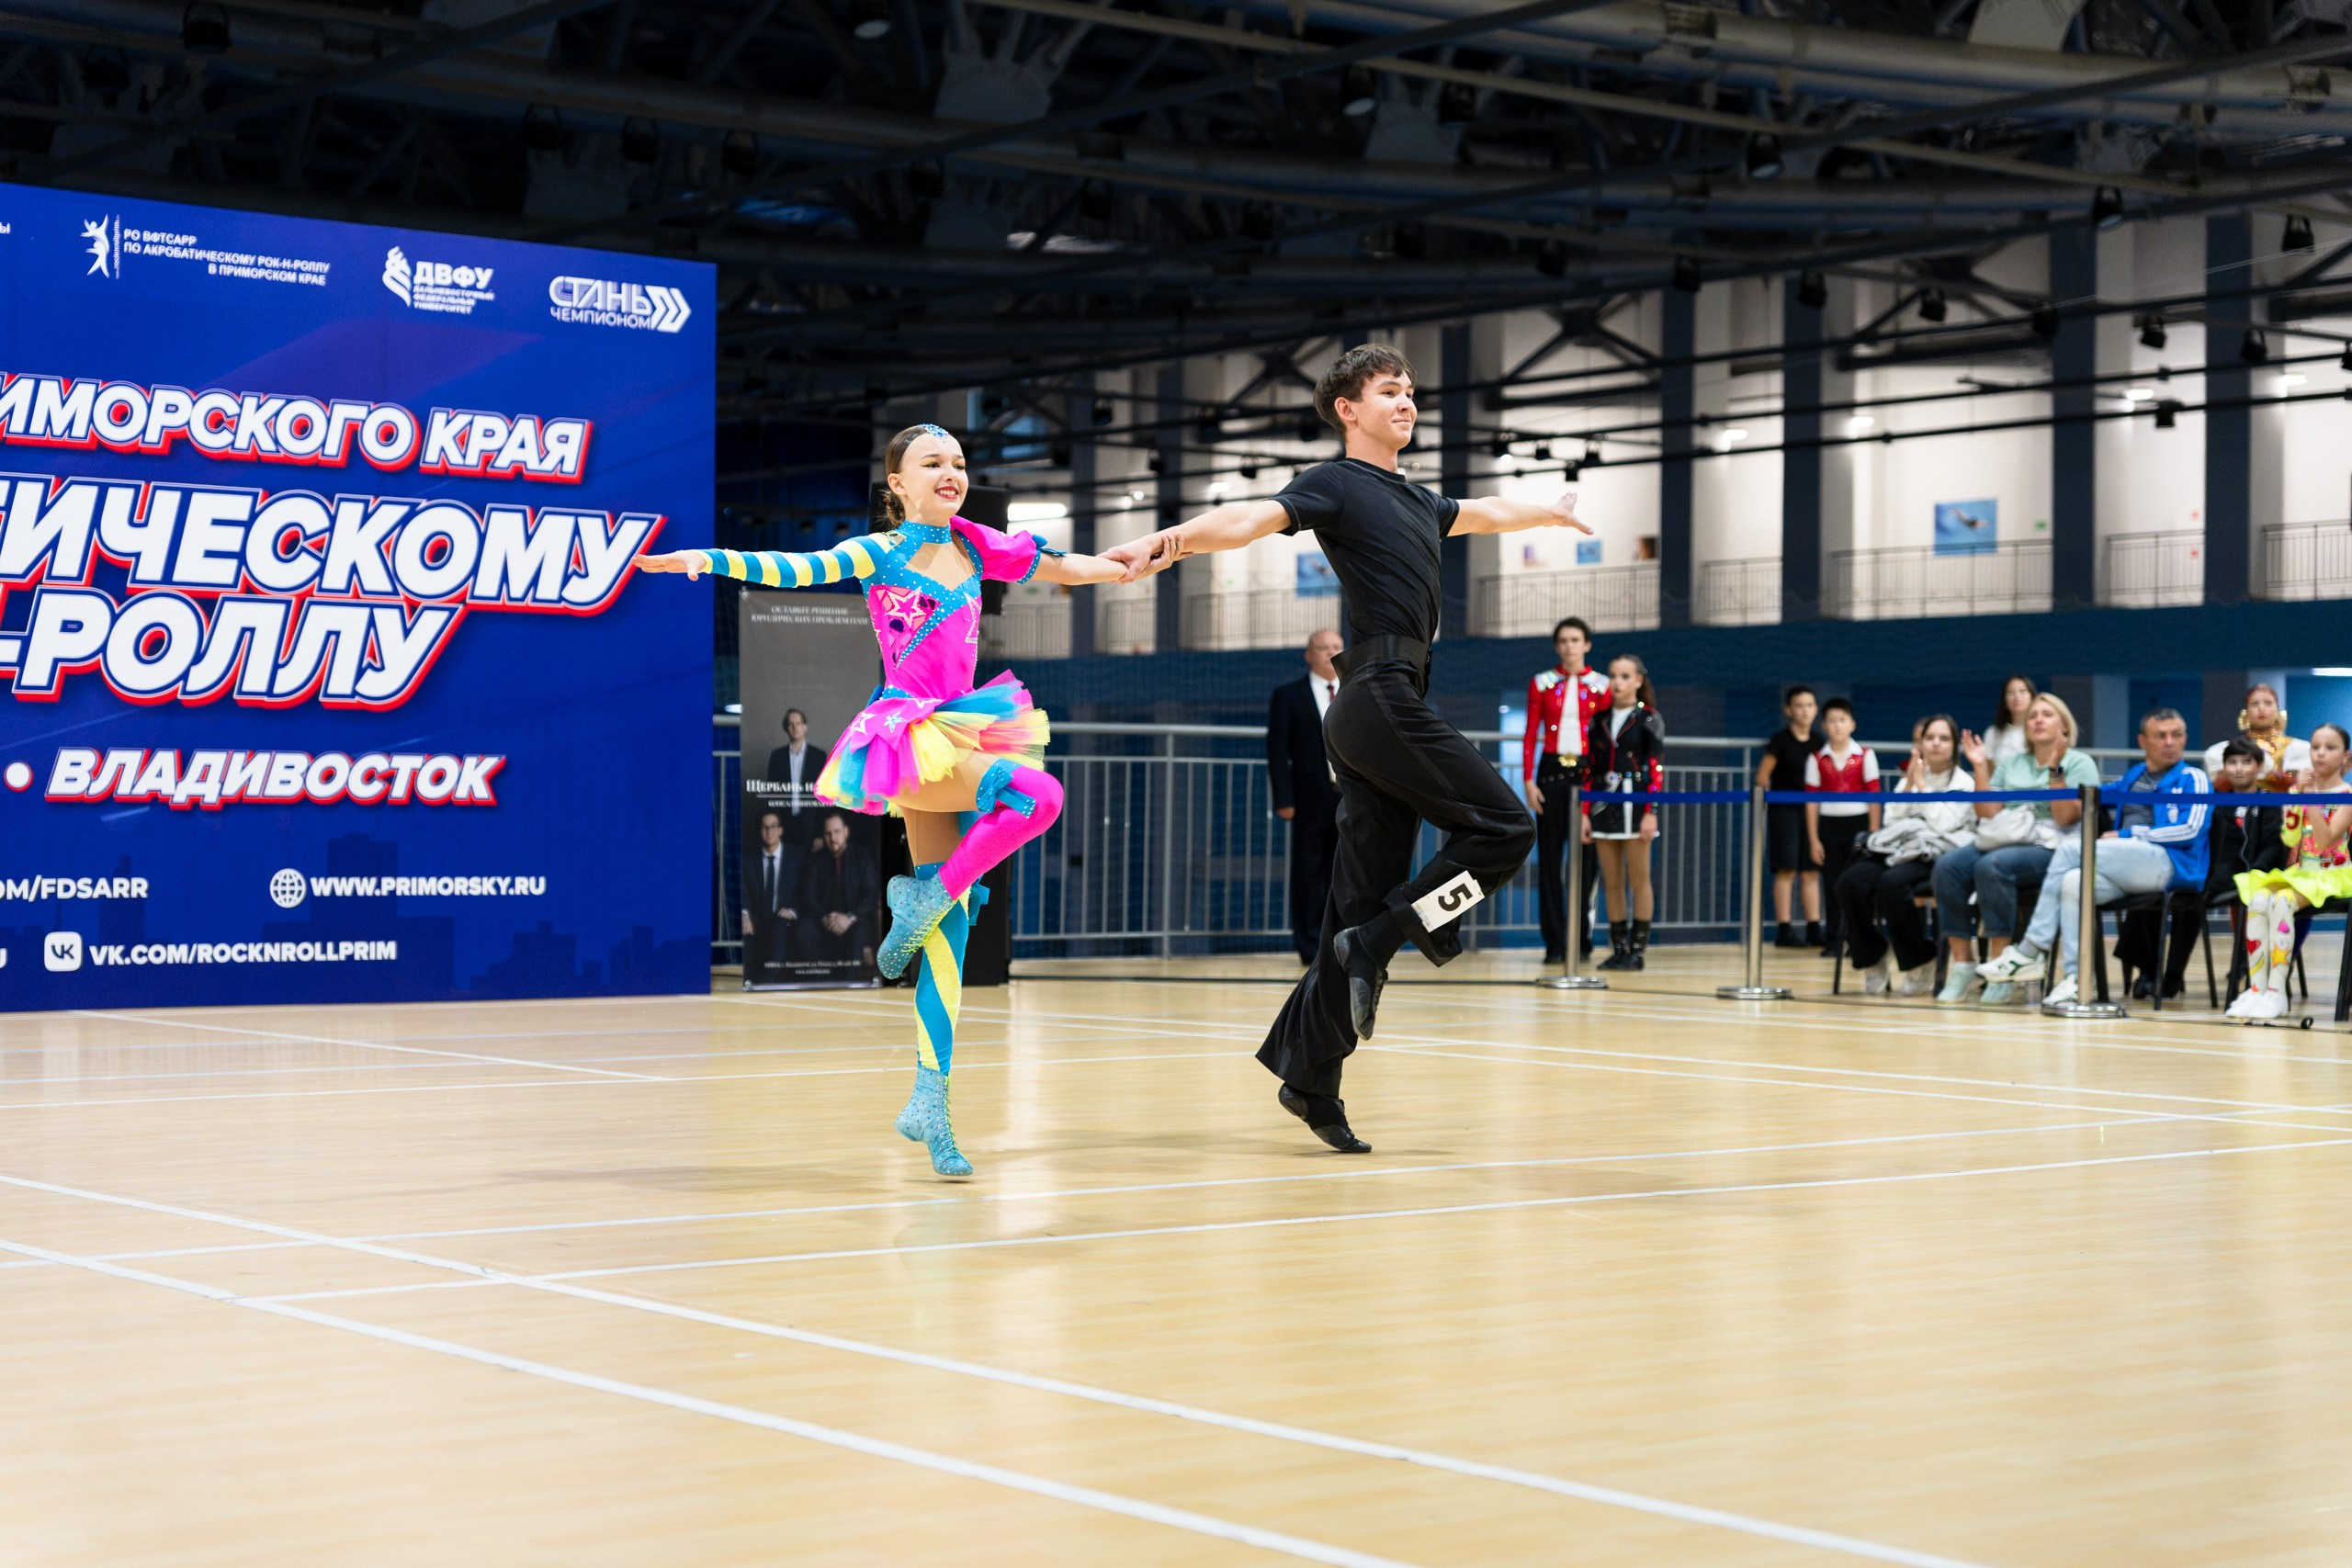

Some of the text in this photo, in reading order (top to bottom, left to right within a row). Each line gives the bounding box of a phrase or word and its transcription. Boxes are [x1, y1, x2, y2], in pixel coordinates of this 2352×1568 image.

[124, 229, 197, 246] РО ВФТСАРР
[124, 242, 330, 274] ПО АКРОБАТИЧЕСКОМУ РОК-Н-РОЛЛУ
[209, 264, 326, 287] В ПРИМОРСКОМ КРАЕ
[413, 261, 494, 289] ДВФУ
[549, 276, 653, 316] СТАНЬ
[550, 307, 652, 331] ЧЕМПИОНОМ
[424, 409, 588, 478] КРАЯ
[0, 472, 662, 608] ИЧЕСКОМУ
[44, 748, 504, 806] ВЛАДИВОСТОК
[0, 874, 149, 903] M/FDSARR
[311, 876, 547, 897] WWW.PRIMORSKY.RU
[1438, 883, 1473, 912] 5
[89, 941, 398, 965] VK.COM/ROCKNROLLPRIM
